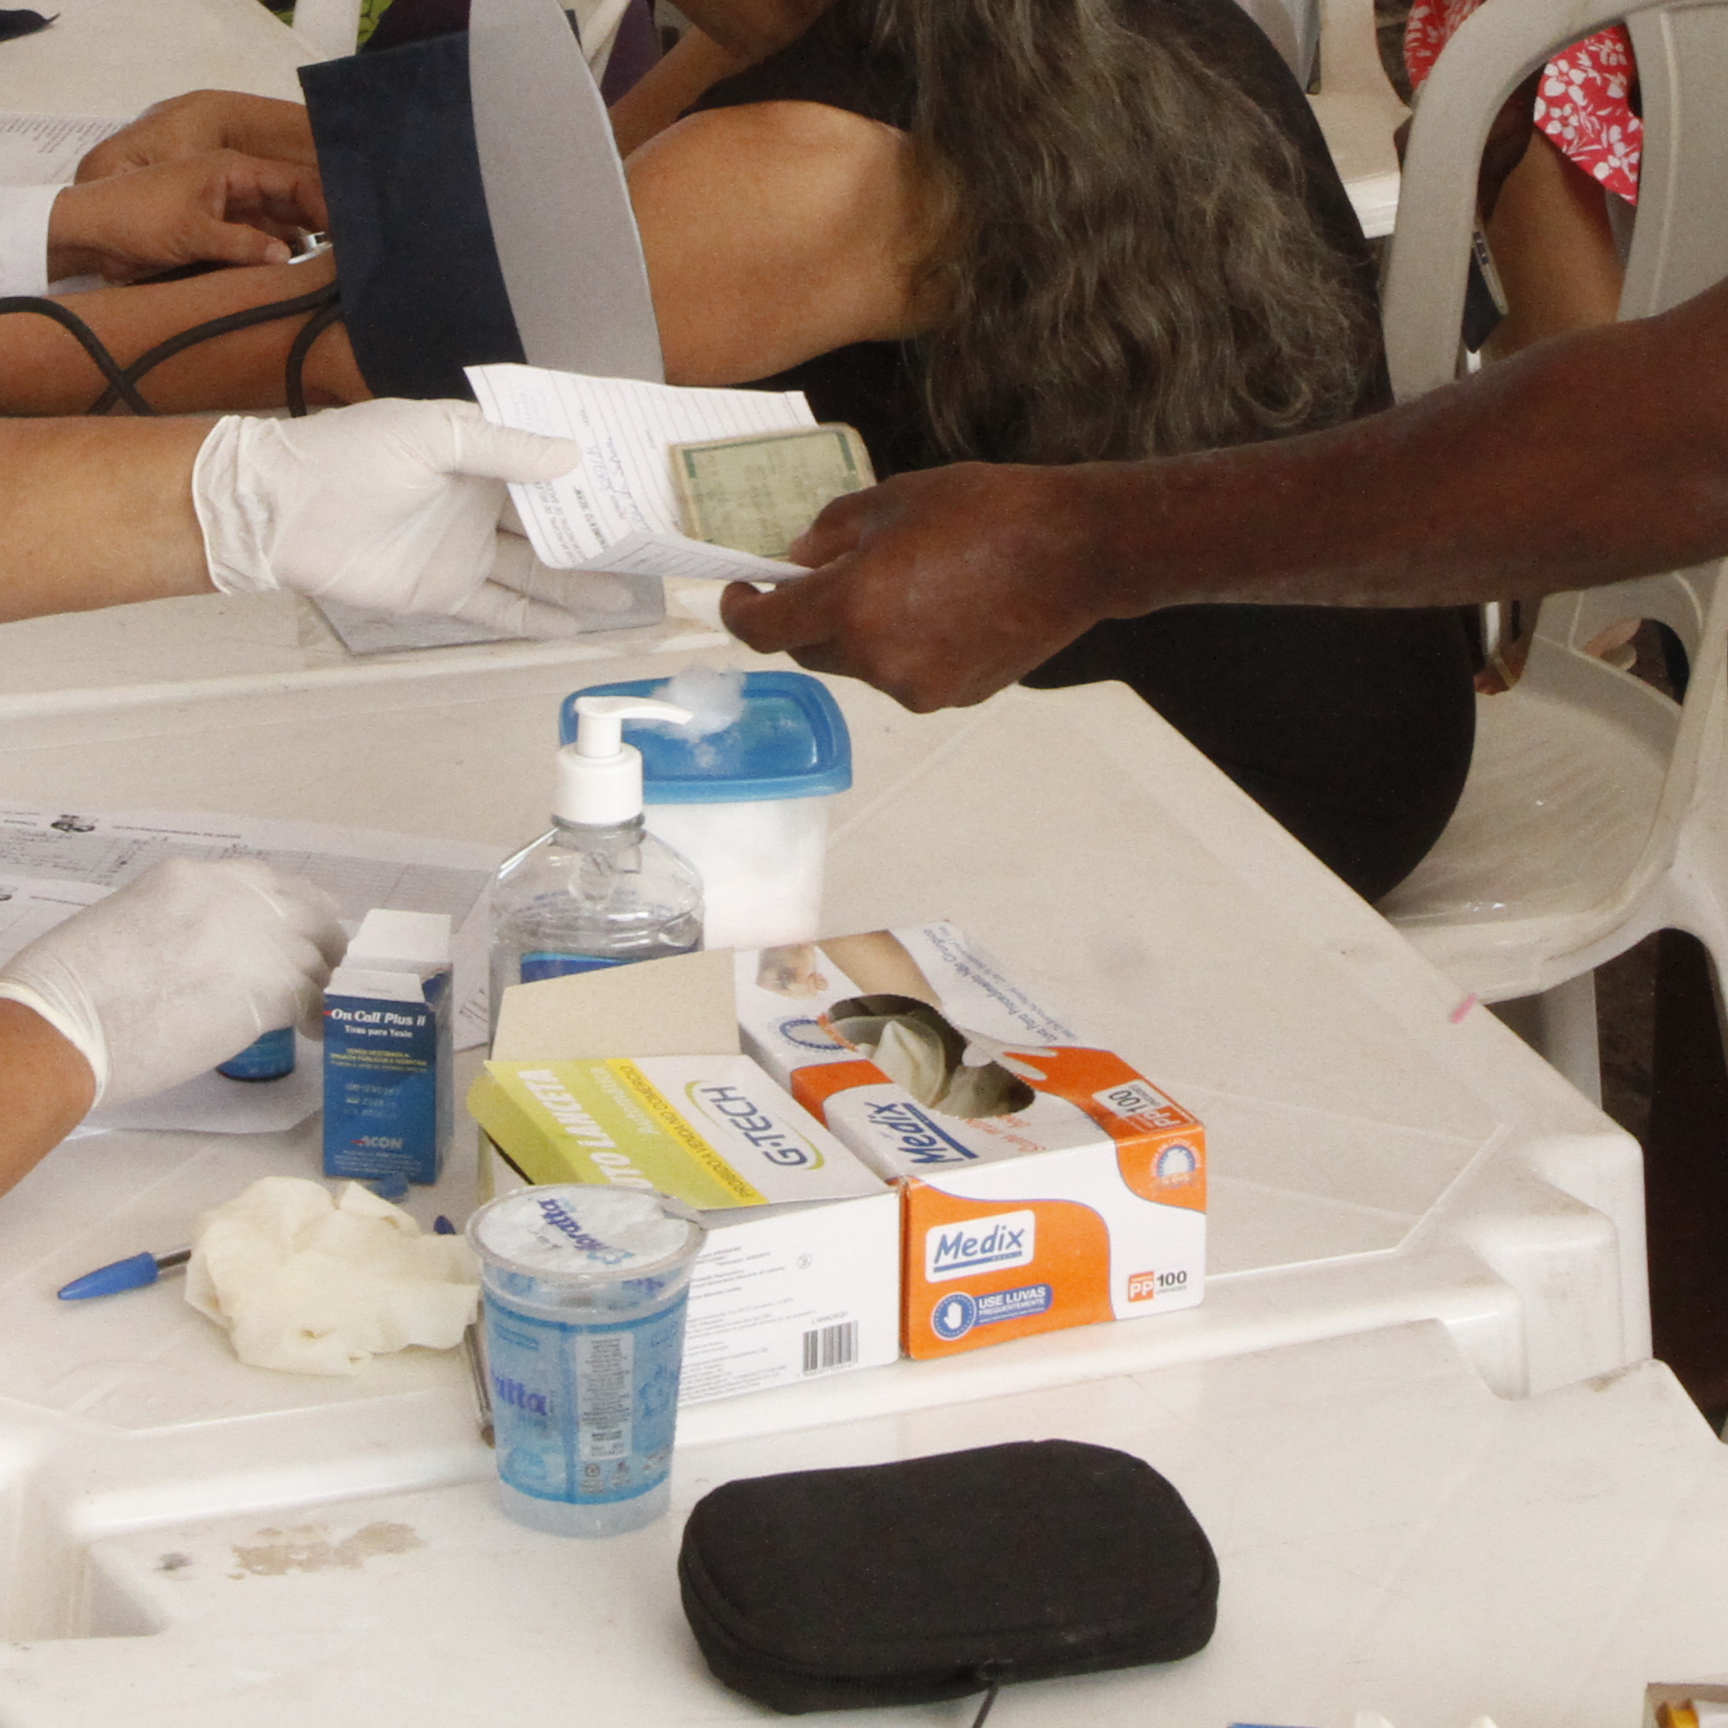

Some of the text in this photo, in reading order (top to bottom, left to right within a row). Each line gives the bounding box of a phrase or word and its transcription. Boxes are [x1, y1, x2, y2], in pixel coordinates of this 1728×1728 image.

[331, 1009, 352, 1020] On
[354, 1010, 381, 1023] Call
[384, 1012, 413, 1025] Plus
[345, 1025, 413, 1038] Tiras para Teste
[1108, 1089, 1182, 1129] PP 100
[359, 1136, 403, 1149] ACON
[517, 1069, 654, 1189] UTO LANCETA
[865, 1102, 964, 1164] Medix
[934, 1225, 1024, 1264] Medix
[979, 1286, 1046, 1309] USE LUVAS
[1130, 1271, 1187, 1298] PP 100
